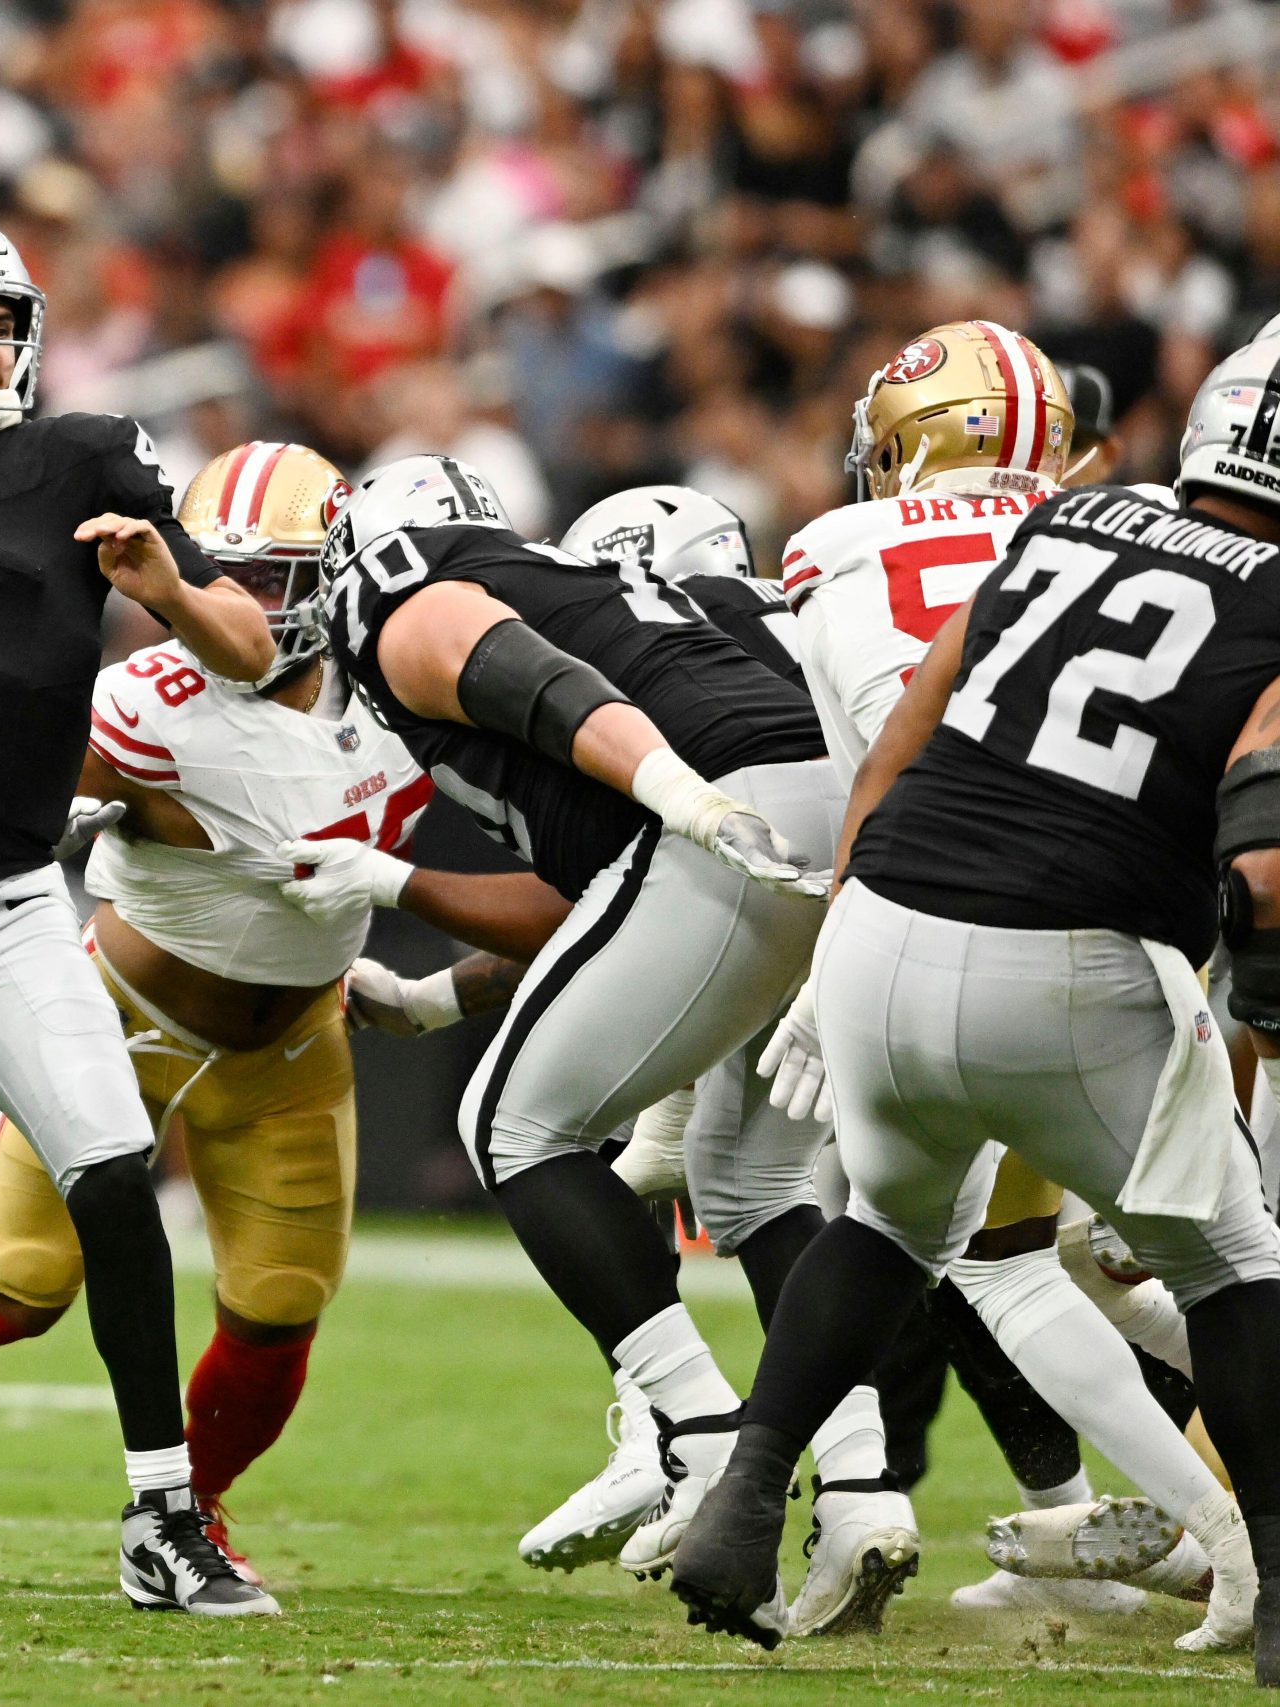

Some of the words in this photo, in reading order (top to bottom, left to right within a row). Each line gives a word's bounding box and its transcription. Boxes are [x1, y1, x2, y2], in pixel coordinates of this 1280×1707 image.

[896, 489, 1061, 526] BRYAN
[1050, 491, 1279, 582] ELUEMUNOR
[325, 530, 428, 657] 70
[125, 651, 206, 708] 58
[941, 534, 1216, 801] 72
[343, 770, 387, 808] 49ERS
